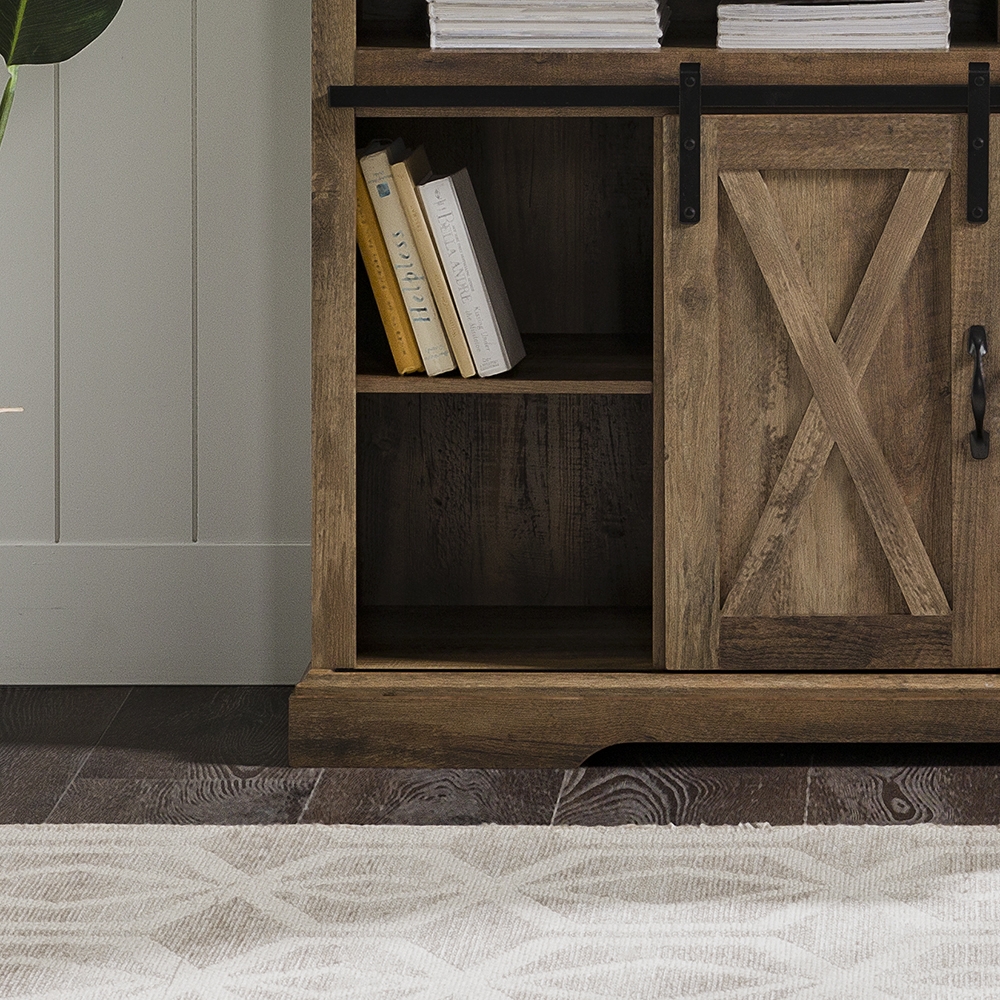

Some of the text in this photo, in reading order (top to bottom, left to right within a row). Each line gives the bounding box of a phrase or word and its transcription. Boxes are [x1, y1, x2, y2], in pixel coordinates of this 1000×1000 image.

[392, 230, 430, 323] Helpless
[437, 210, 457, 259] BELLA
[451, 259, 472, 305] ANDRE
